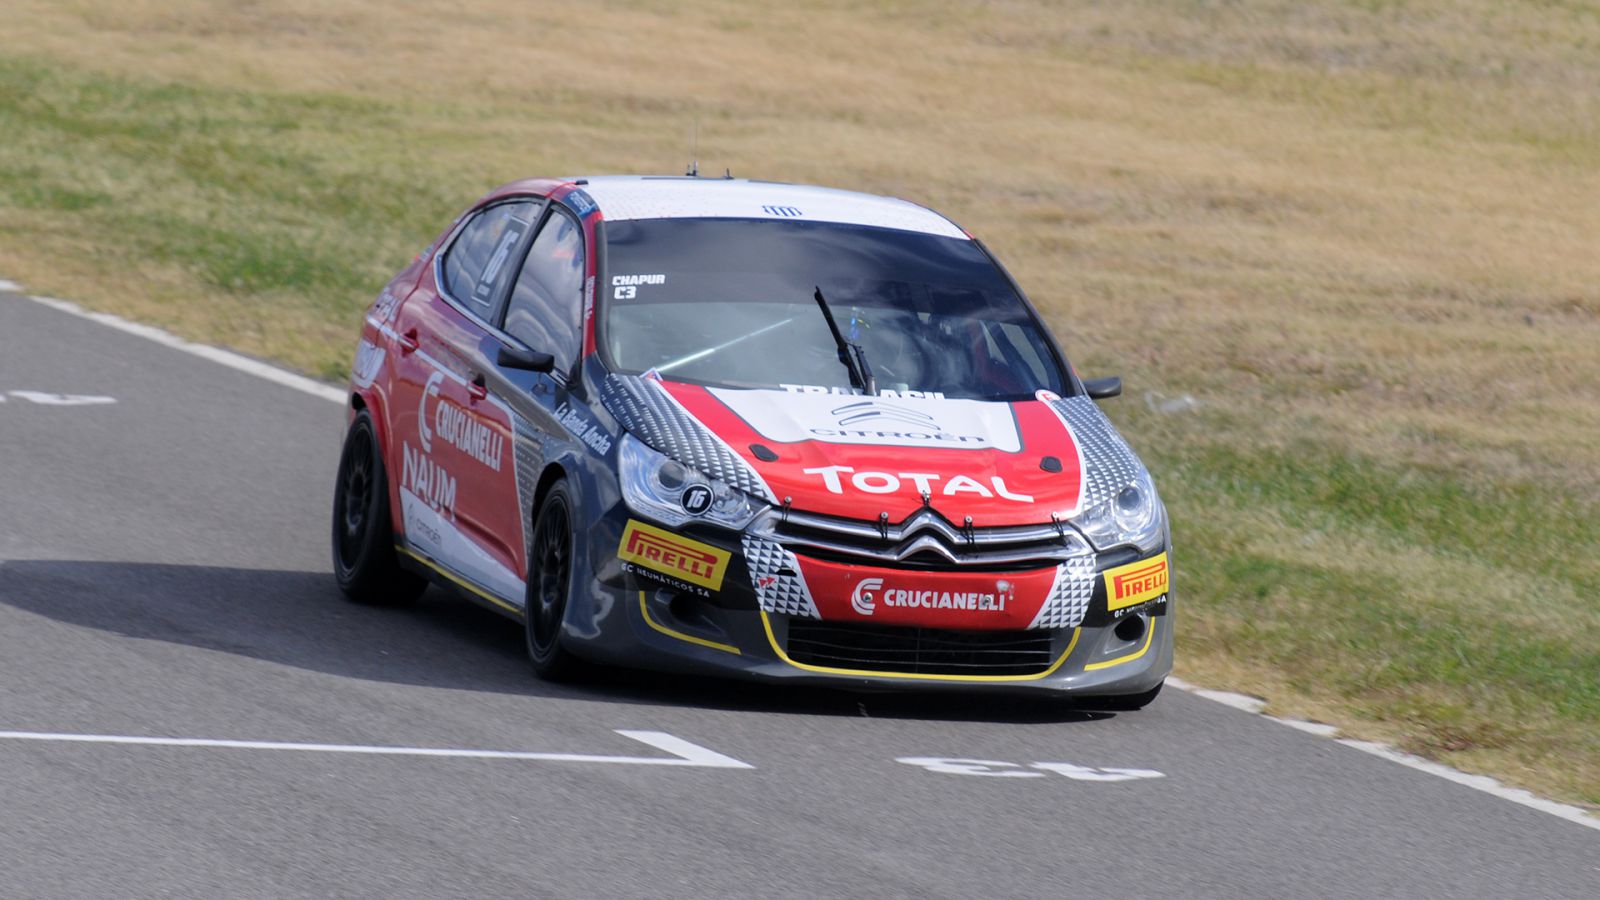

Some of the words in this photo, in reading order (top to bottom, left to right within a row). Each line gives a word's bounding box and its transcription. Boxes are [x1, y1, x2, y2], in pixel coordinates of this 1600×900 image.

[612, 275, 666, 286] CHAPUR
[614, 286, 637, 299] C3
[436, 399, 503, 473] CRUCIANELLI
[402, 440, 458, 523] NAUM
[687, 490, 708, 508] 16
[803, 465, 1035, 504] TOTAL
[626, 529, 719, 580] PIRELLI
[884, 588, 1006, 612] CRUCIANELLI
[1113, 560, 1167, 601] PIRELLI
